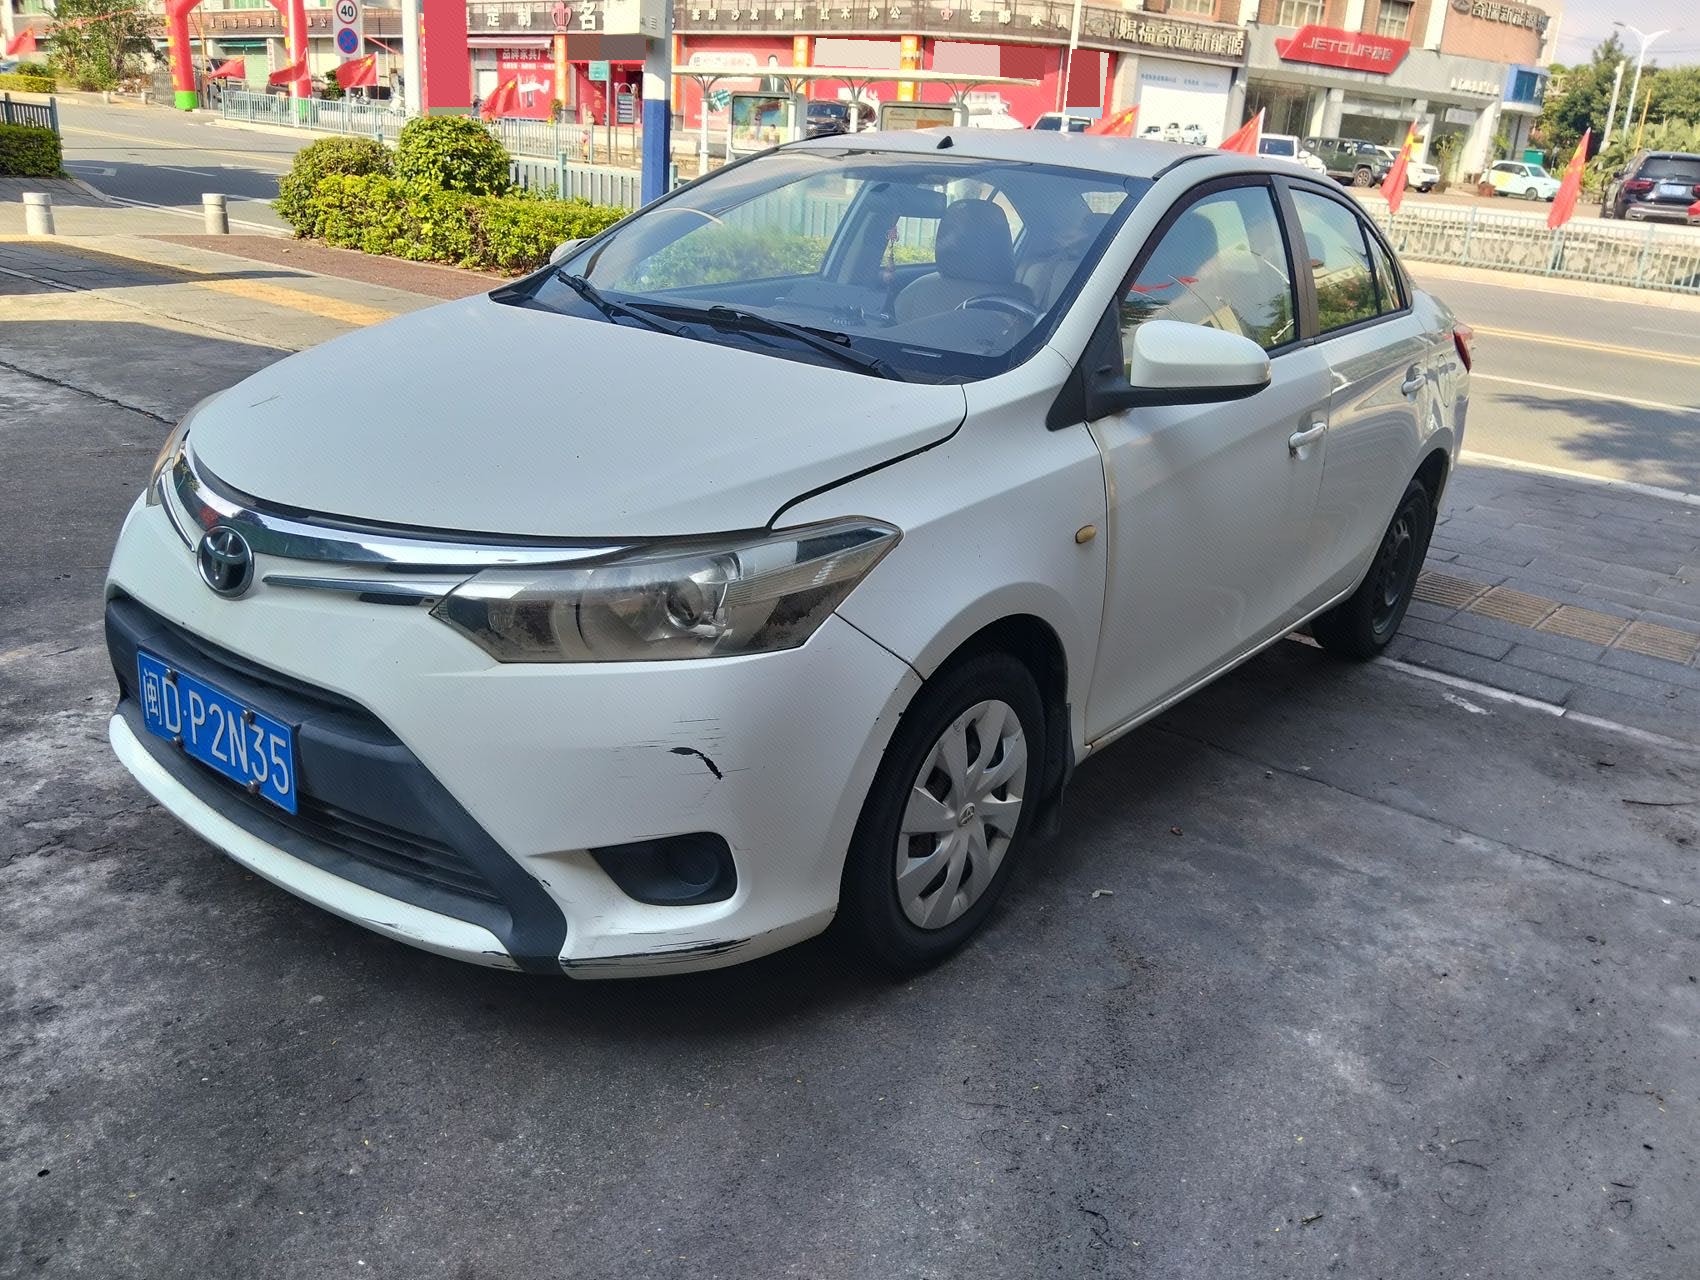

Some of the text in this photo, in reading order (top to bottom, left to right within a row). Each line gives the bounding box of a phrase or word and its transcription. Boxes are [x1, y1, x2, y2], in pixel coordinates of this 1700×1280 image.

[340, 5, 354, 18] 40
[1117, 15, 1245, 57] 赐福奇瑞新能源
